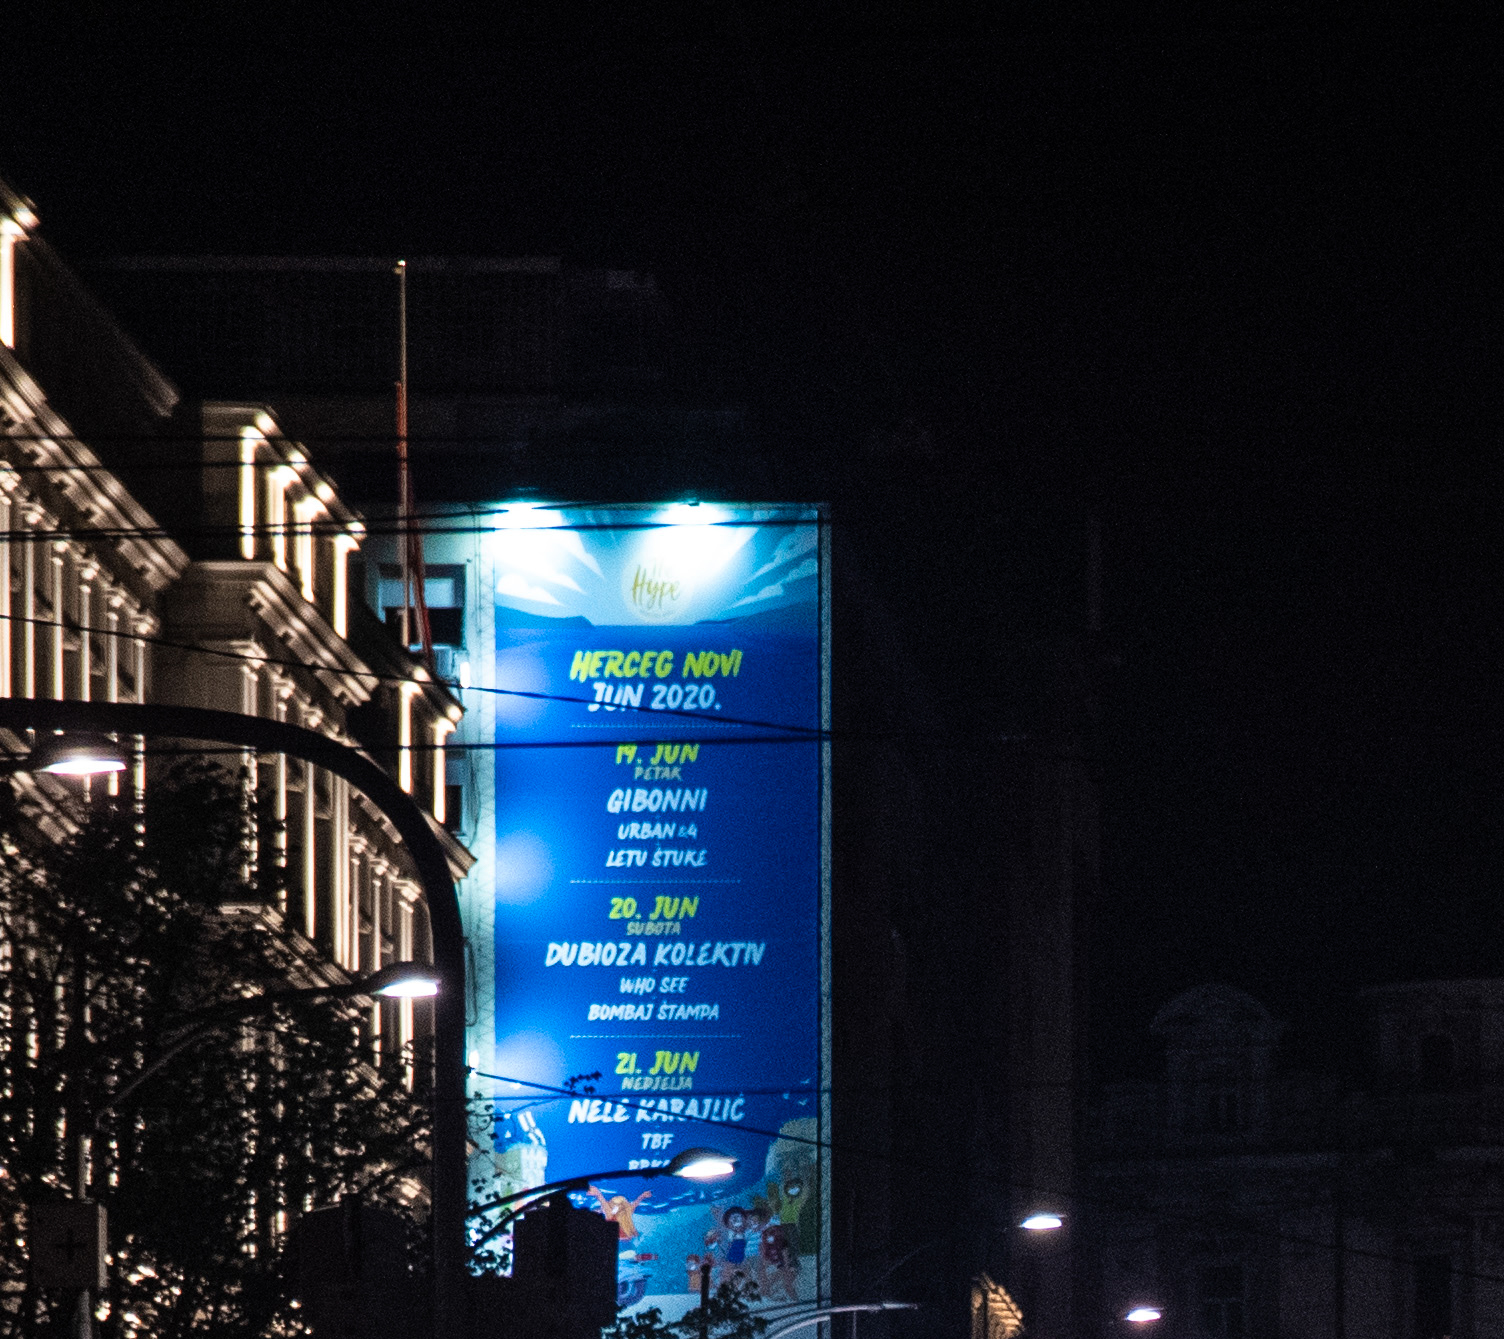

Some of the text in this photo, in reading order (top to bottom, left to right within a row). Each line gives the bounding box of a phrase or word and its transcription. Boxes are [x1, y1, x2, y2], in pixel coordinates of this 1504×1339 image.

[630, 564, 681, 609] Hype
[569, 648, 743, 683] HERCEG NOVI
[588, 682, 722, 712] JUN 2020.
[650, 743, 700, 765] JUN
[634, 766, 682, 781] PETAK
[607, 788, 708, 814] GIBONNI
[617, 822, 677, 840] URBAN
[605, 846, 708, 868] LETU ŠTUKE
[609, 895, 700, 920] 20. JUN
[626, 921, 681, 936] SUBOTA
[545, 941, 765, 967] DUBIOZA KOLEKTIV
[619, 976, 689, 995] WHO SEE
[588, 1000, 720, 1021] BOMBAJ ŠTAMPA
[615, 1051, 700, 1075] 21. JUN
[621, 1076, 693, 1091] NEDJELJA
[568, 1098, 630, 1124] NELE
[641, 1133, 674, 1150] TBF
